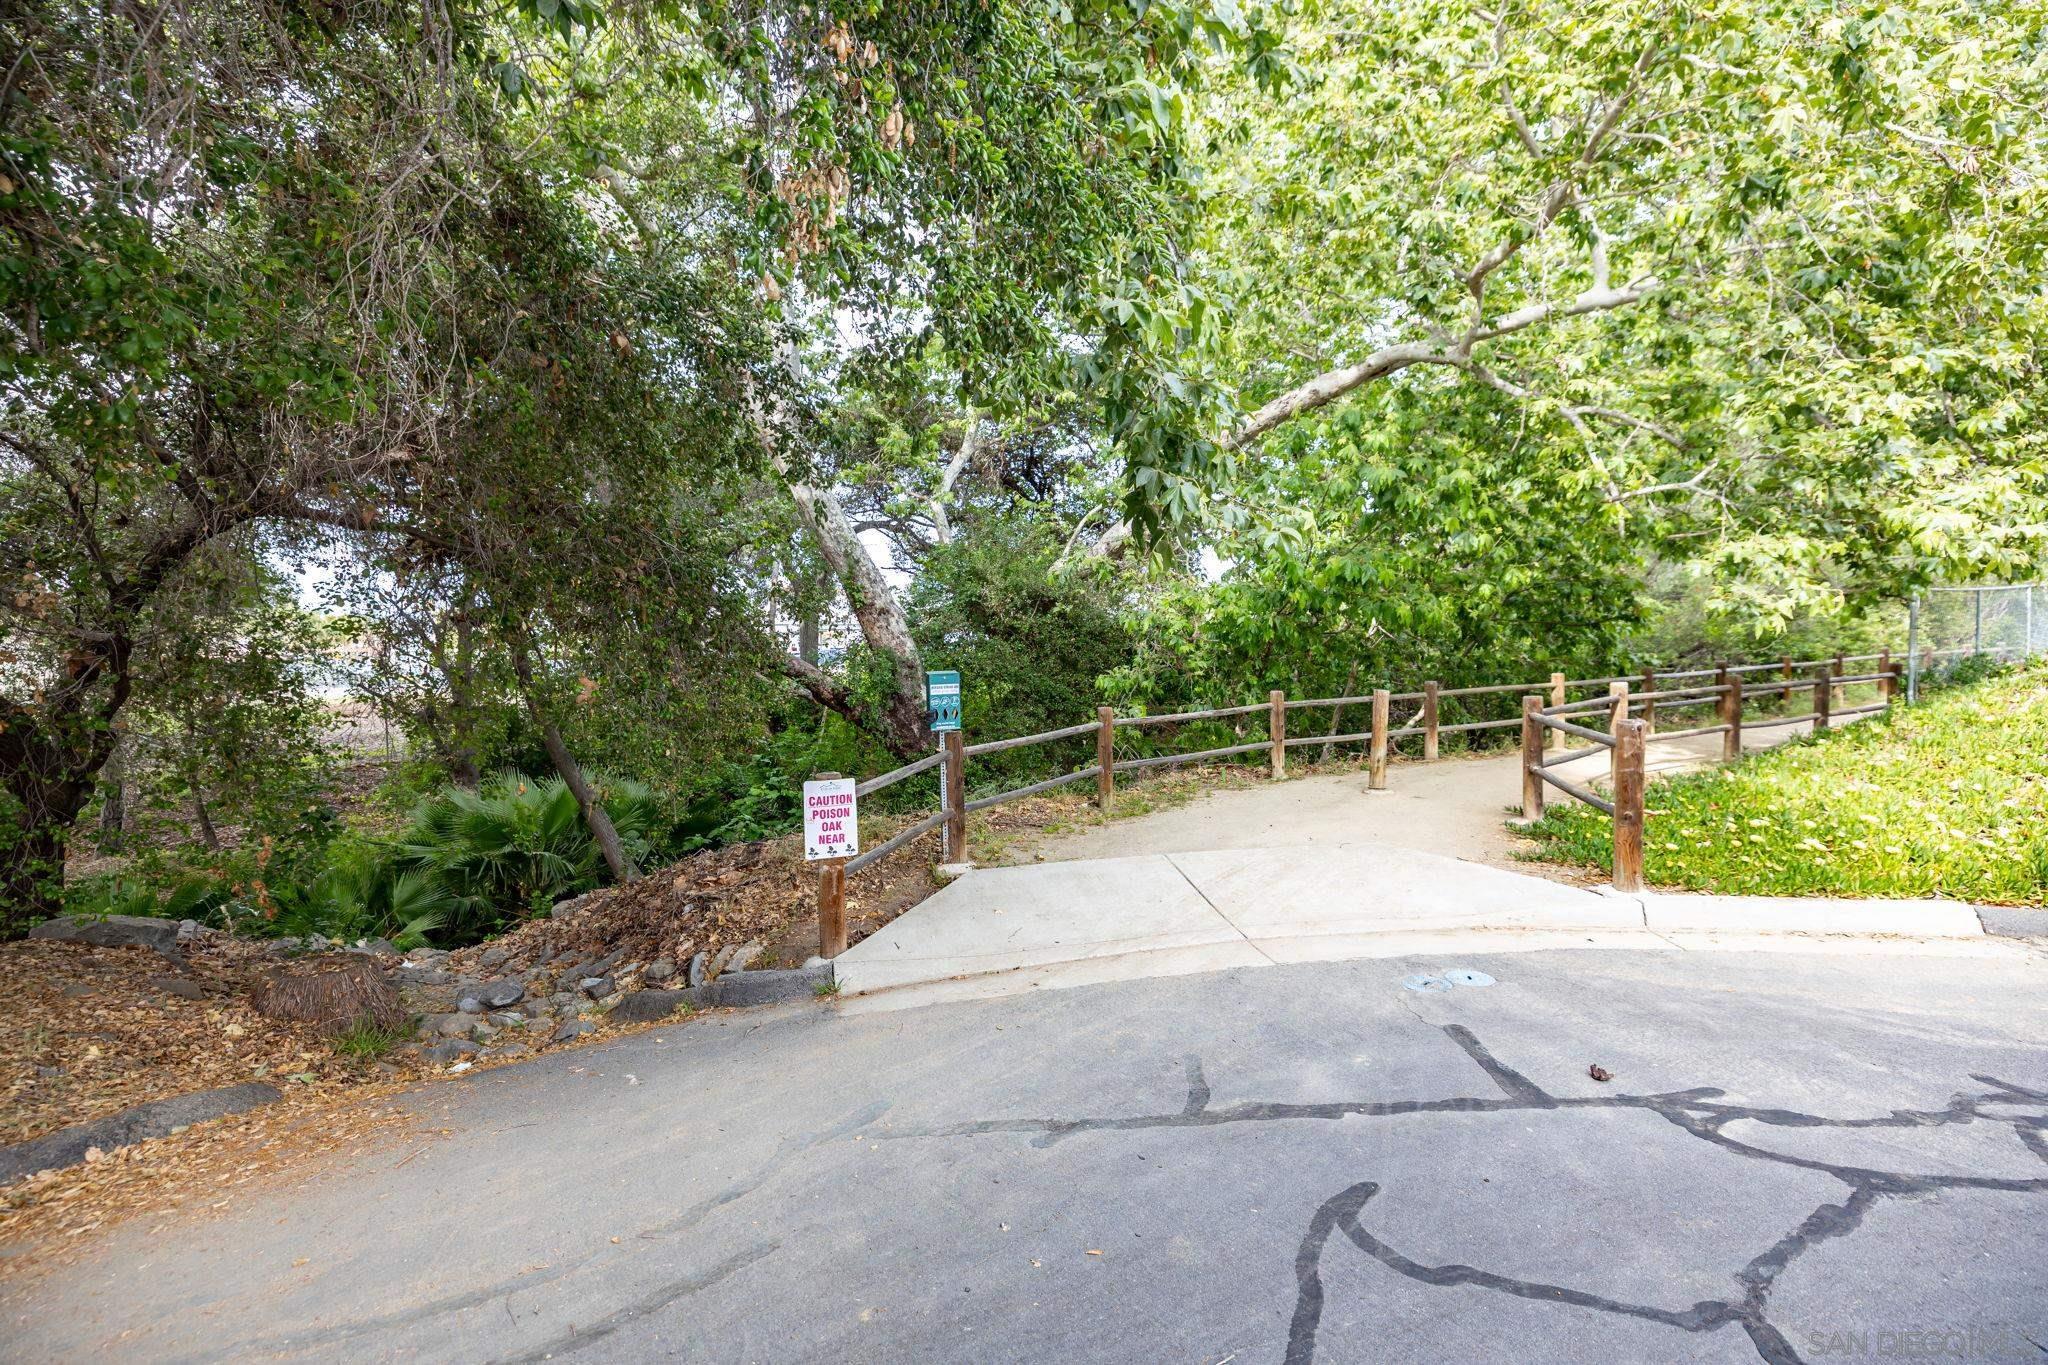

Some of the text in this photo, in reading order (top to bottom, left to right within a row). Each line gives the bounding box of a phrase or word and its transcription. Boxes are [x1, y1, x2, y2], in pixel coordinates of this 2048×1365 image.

[808, 794, 853, 807] CAUTION
[812, 807, 850, 820] POISON
[821, 821, 842, 832] OAK
[818, 834, 845, 845] NEAR
